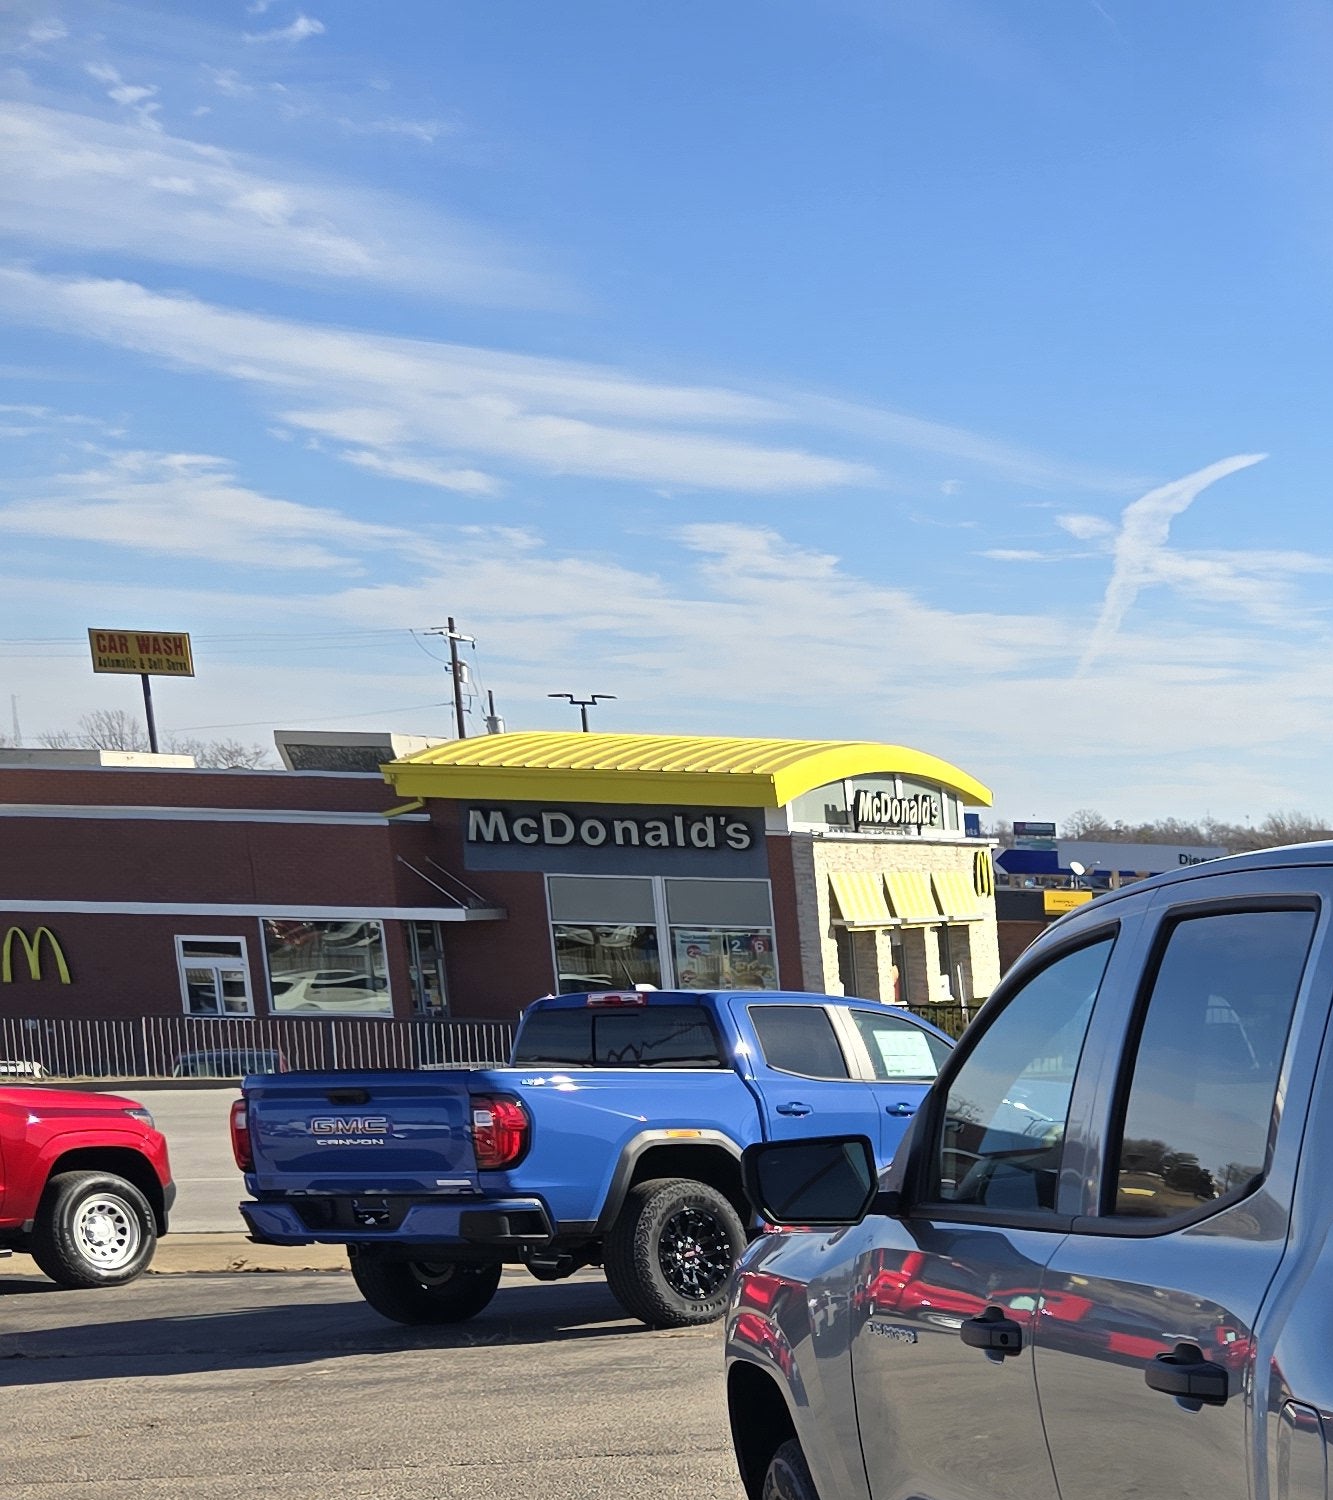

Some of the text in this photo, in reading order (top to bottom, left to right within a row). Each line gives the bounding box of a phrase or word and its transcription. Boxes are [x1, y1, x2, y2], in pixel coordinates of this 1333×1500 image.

[96, 634, 184, 657] CAR WASH
[858, 790, 940, 827] McDonald's
[467, 809, 753, 850] McDonald's
[310, 1116, 387, 1136] GMC
[316, 1138, 384, 1146] CANYON
